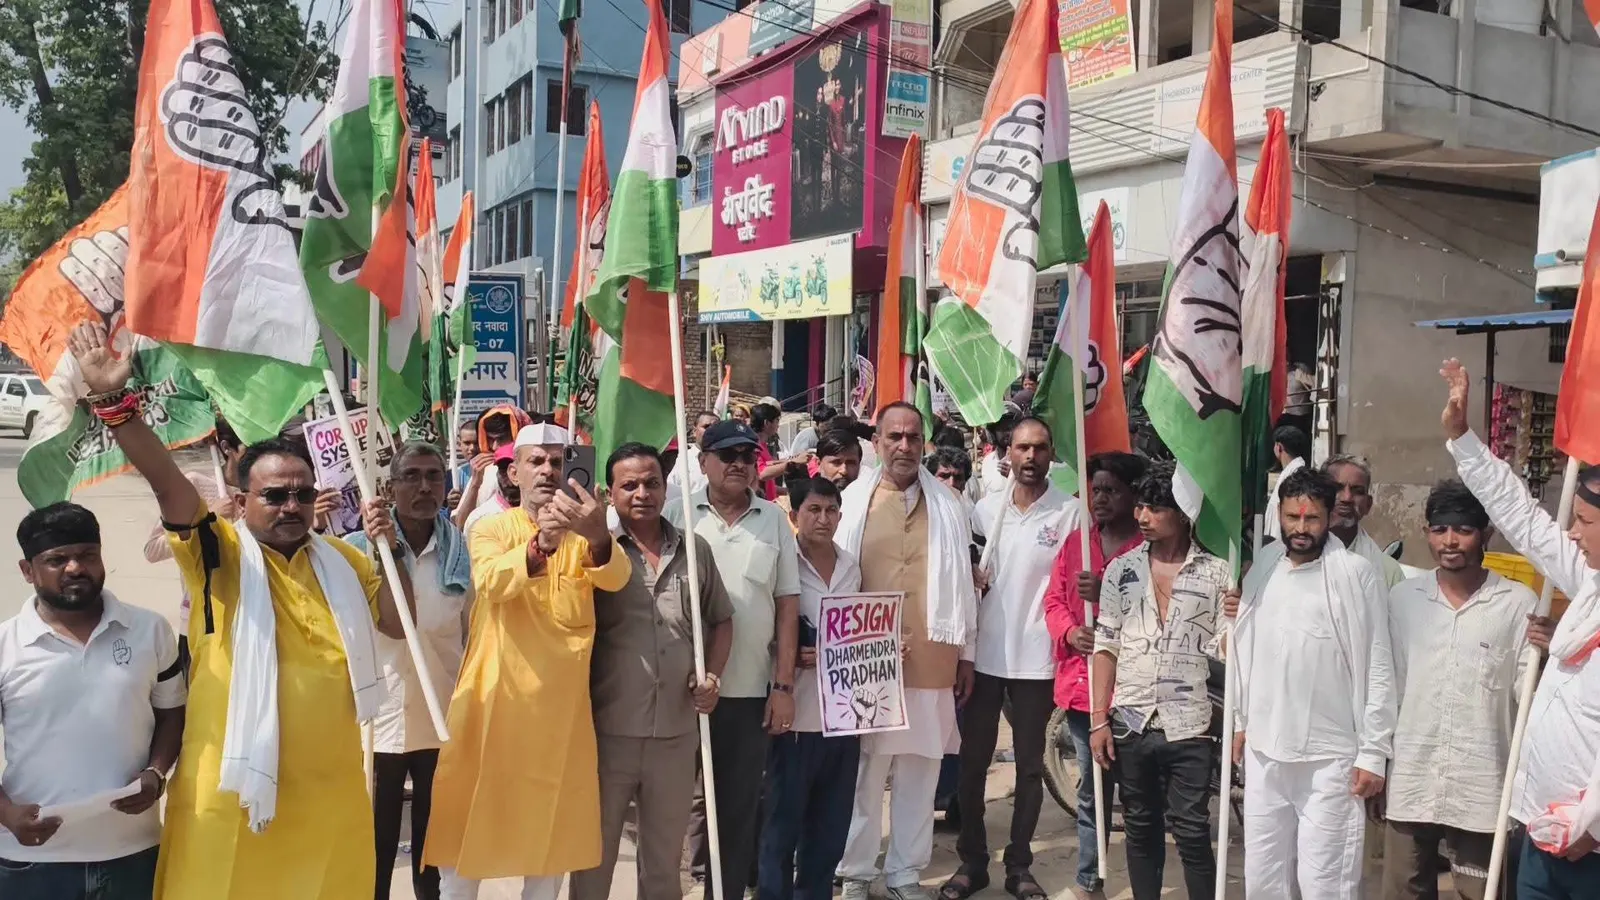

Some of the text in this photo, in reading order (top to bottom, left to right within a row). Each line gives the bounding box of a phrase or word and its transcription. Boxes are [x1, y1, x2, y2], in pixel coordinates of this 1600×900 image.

[886, 103, 925, 120] Infinix
[732, 138, 768, 166] STORE
[830, 239, 850, 247] SUZUKI
[484, 321, 508, 332] नवादा
[700, 312, 712, 321] SHIV
[713, 310, 750, 320] AUTOMOBILE
[315, 418, 368, 451] CORUP
[826, 602, 897, 642] RESIGN
[825, 639, 897, 670] DHARMENDRA
[828, 658, 896, 695] PRADHAN
